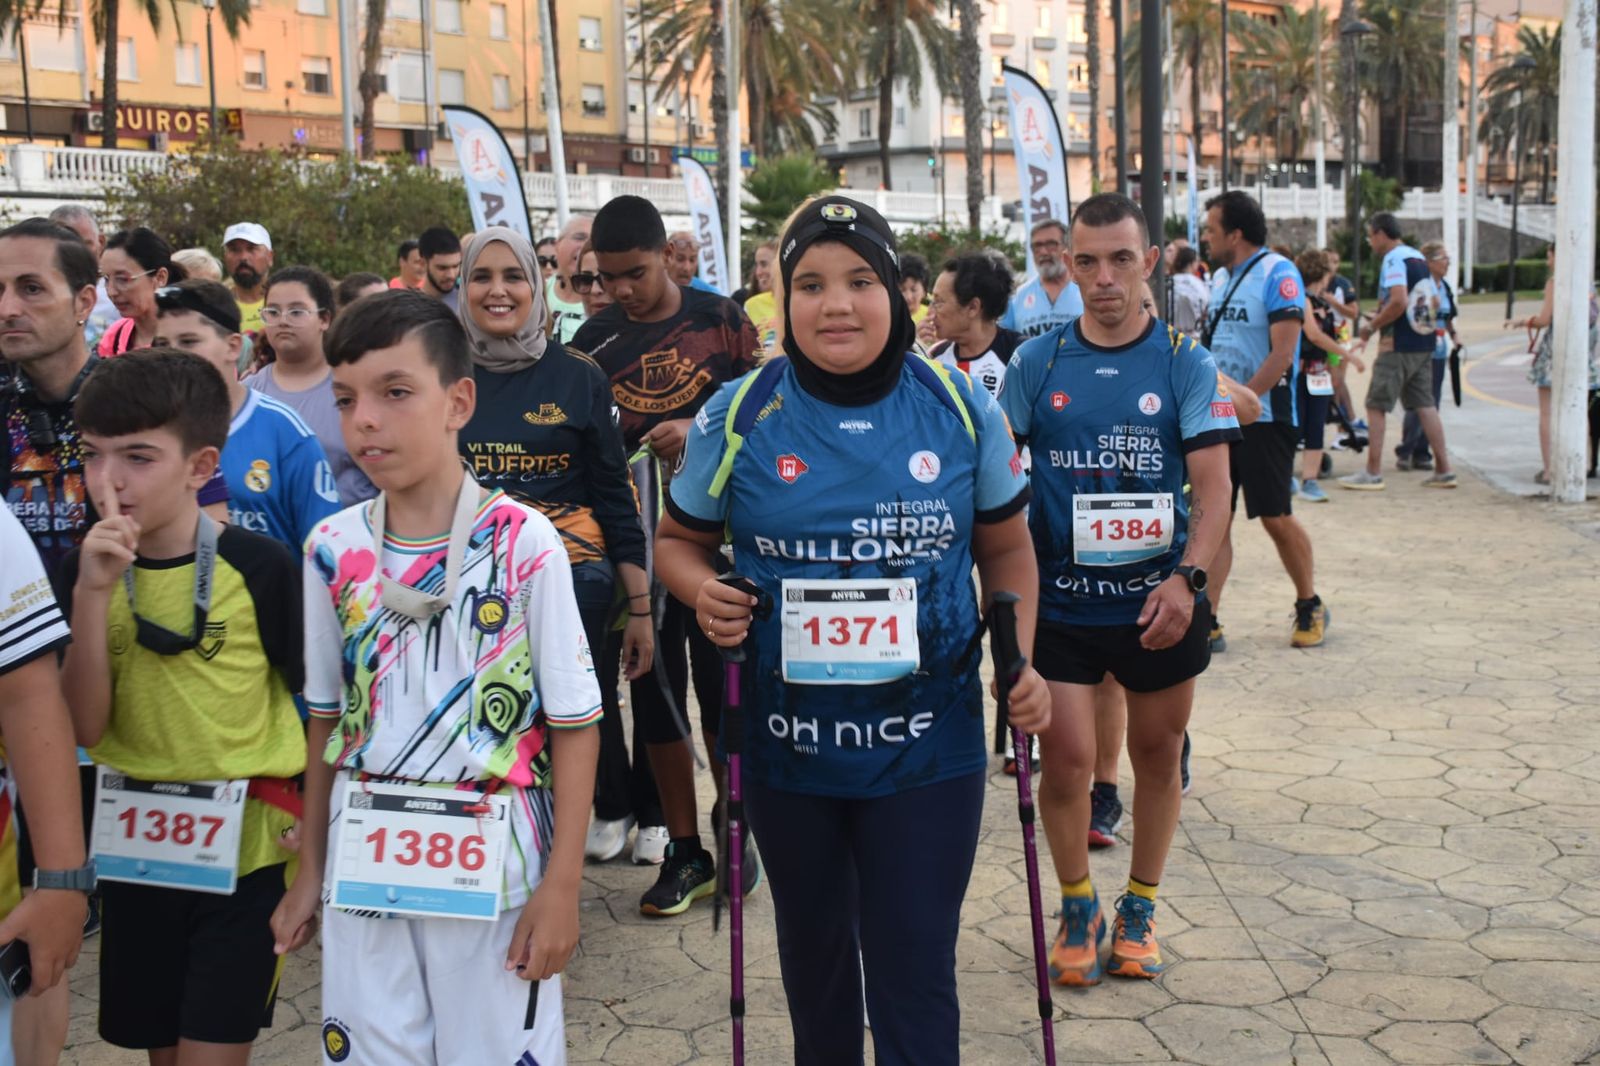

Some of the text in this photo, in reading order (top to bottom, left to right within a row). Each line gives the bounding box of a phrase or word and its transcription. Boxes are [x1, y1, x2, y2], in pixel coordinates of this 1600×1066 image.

[644, 400, 666, 410] LOS
[1113, 425, 1160, 436] INTEGRAL
[467, 443, 527, 454] VI TRAIL
[1098, 435, 1162, 452] SIERRA
[474, 453, 570, 473] FUERTES
[1050, 450, 1163, 472] BULLONES
[875, 498, 950, 516] INTEGRAL
[851, 513, 956, 537] SIERRA
[1090, 518, 1163, 541] 1384
[755, 533, 954, 562] BULLONES
[831, 591, 866, 601] ANYERA
[803, 615, 899, 646] 1371
[768, 713, 819, 743] OH
[118, 806, 225, 848] 1387
[365, 827, 486, 871] 1386
